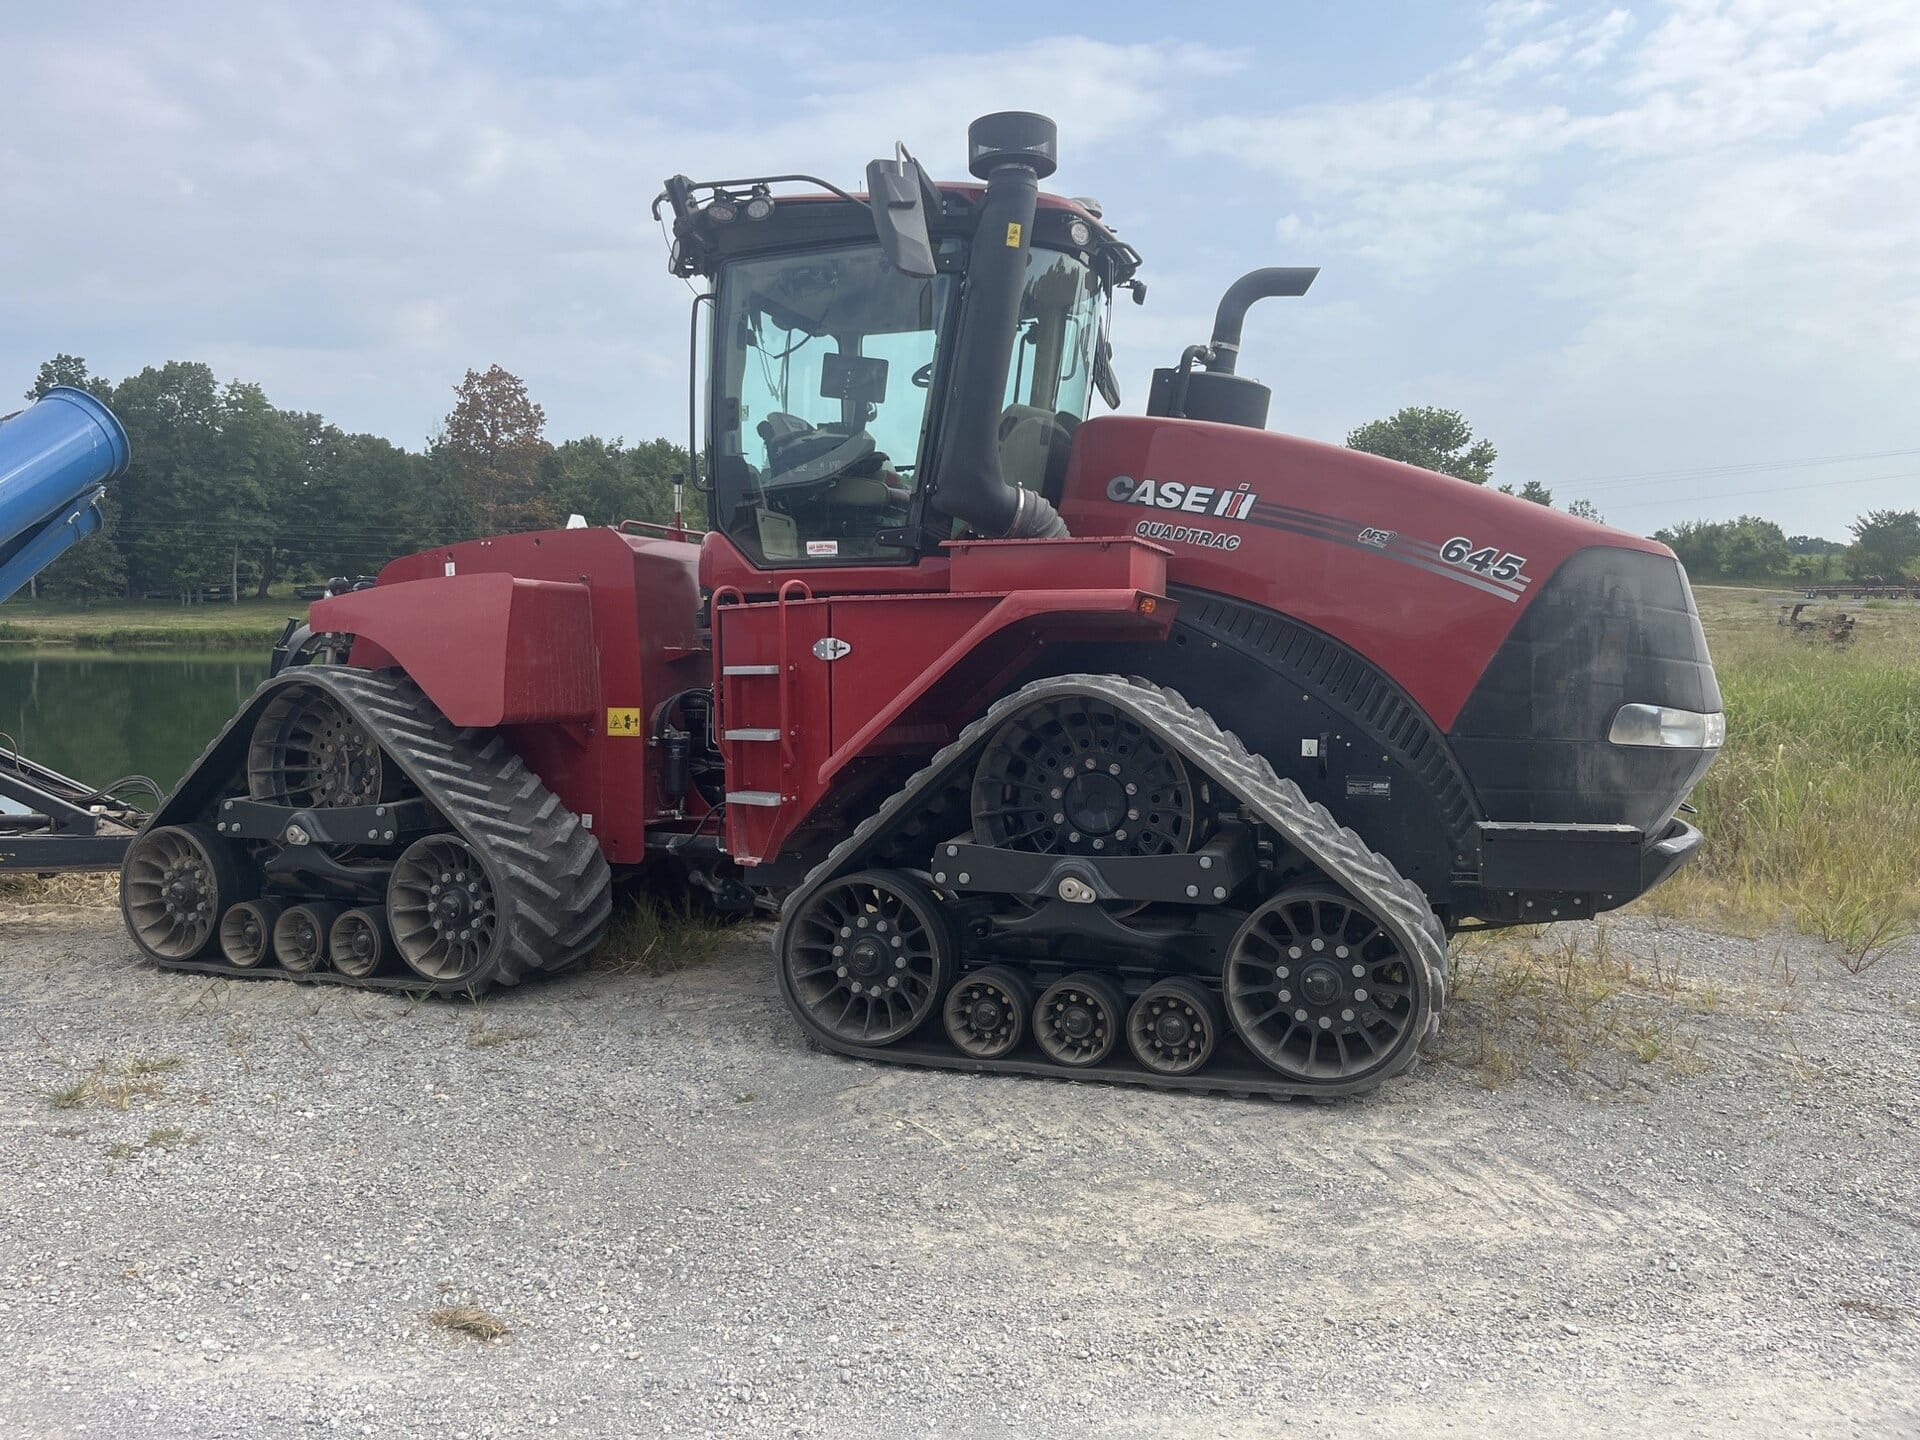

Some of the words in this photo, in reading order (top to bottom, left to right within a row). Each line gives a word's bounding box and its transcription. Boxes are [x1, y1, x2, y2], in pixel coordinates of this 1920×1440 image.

[1106, 475, 1214, 513] CASE
[1136, 520, 1240, 550] QUADTRAC
[1440, 536, 1528, 582] 645
